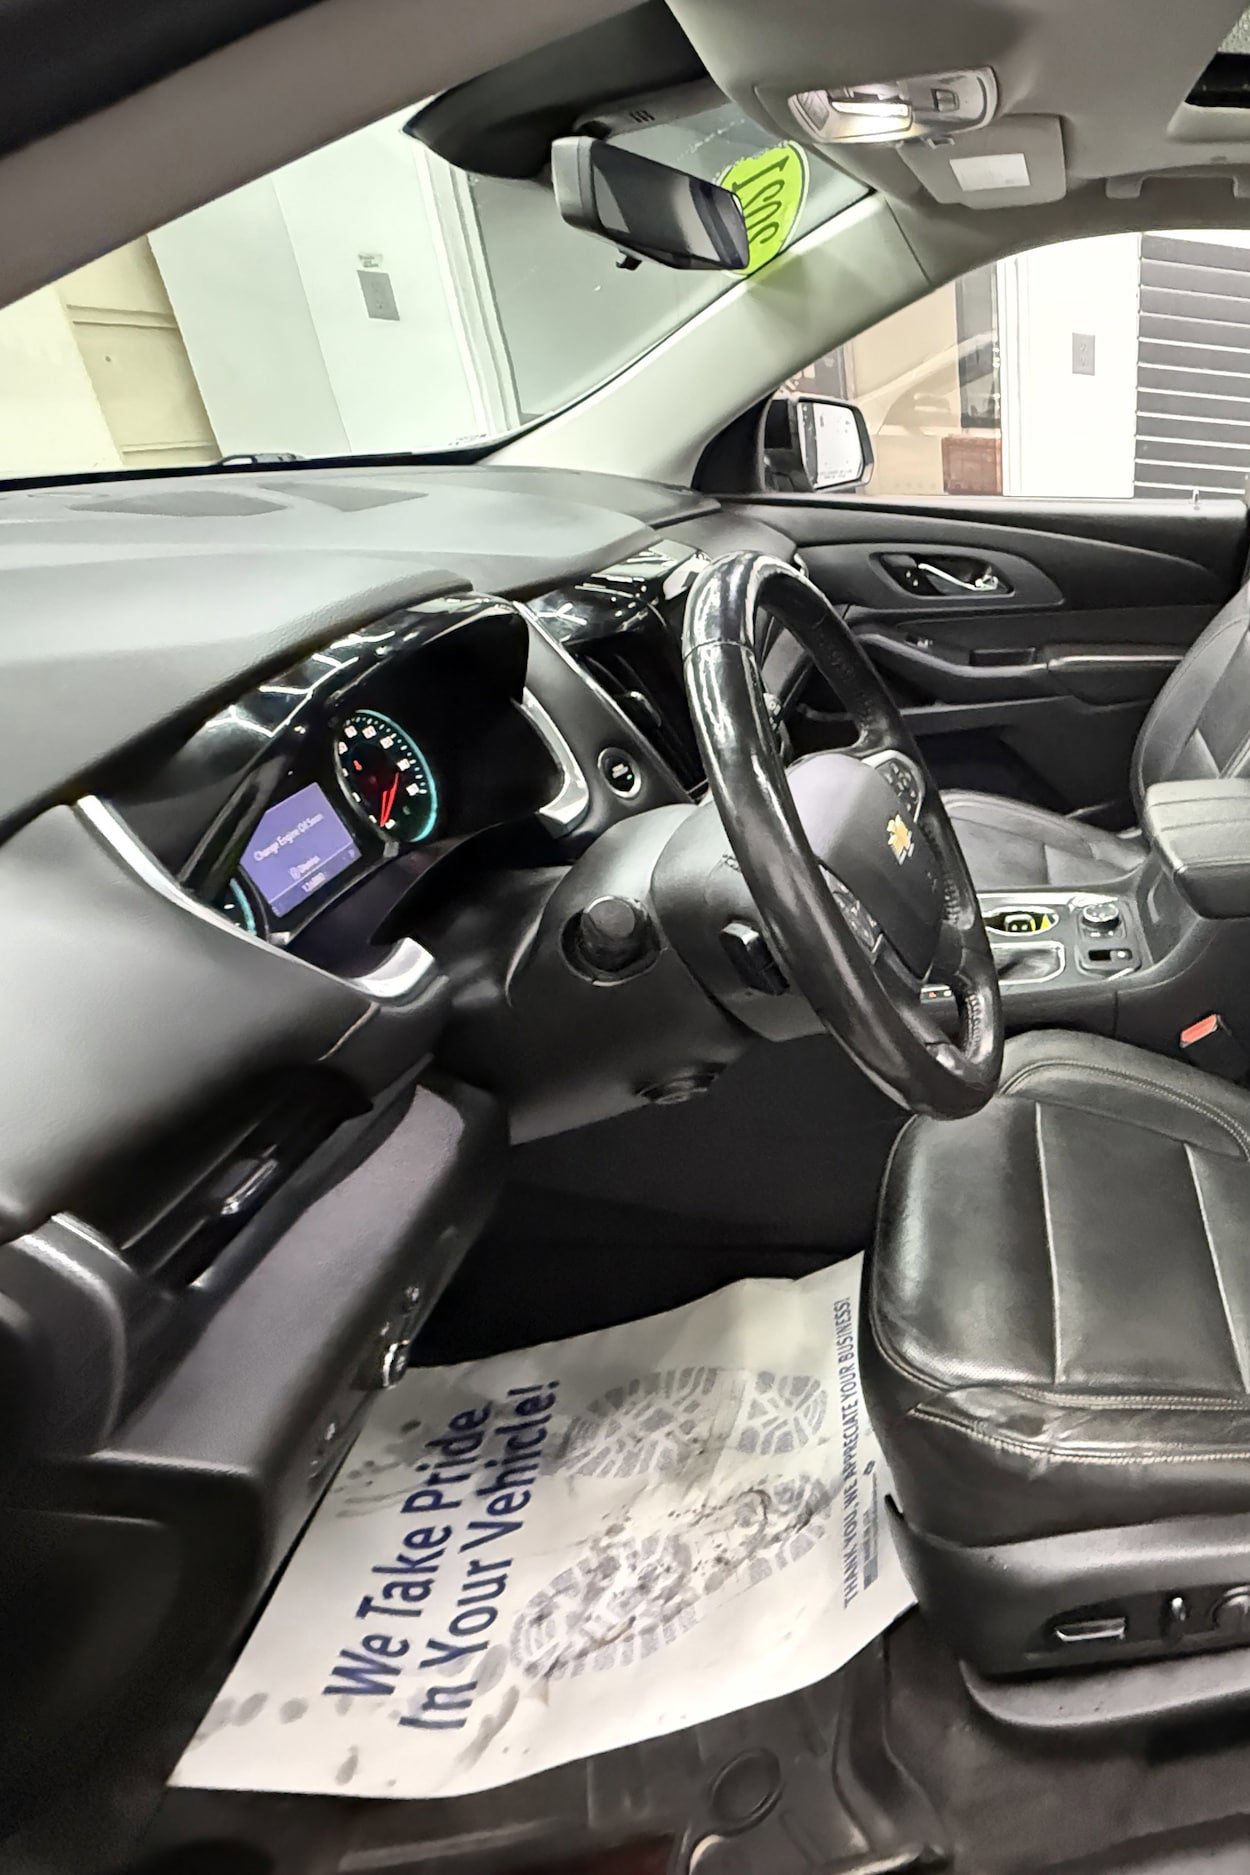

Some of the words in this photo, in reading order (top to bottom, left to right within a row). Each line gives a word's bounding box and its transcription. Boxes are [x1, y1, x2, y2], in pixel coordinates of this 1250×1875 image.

[833, 1297, 855, 1364] BUSINESS!
[839, 1362, 858, 1403] YOUR
[400, 1402, 491, 1514] Pride
[458, 1380, 561, 1553] Vehicle!
[841, 1399, 859, 1482] APPRECIATE
[843, 1478, 859, 1511] WE
[843, 1500, 860, 1549] YOU,
[355, 1524, 453, 1620] Take
[843, 1542, 859, 1609] THANK
[418, 1557, 514, 1670] Your
[323, 1633, 411, 1696] We
[398, 1679, 479, 1730] In
